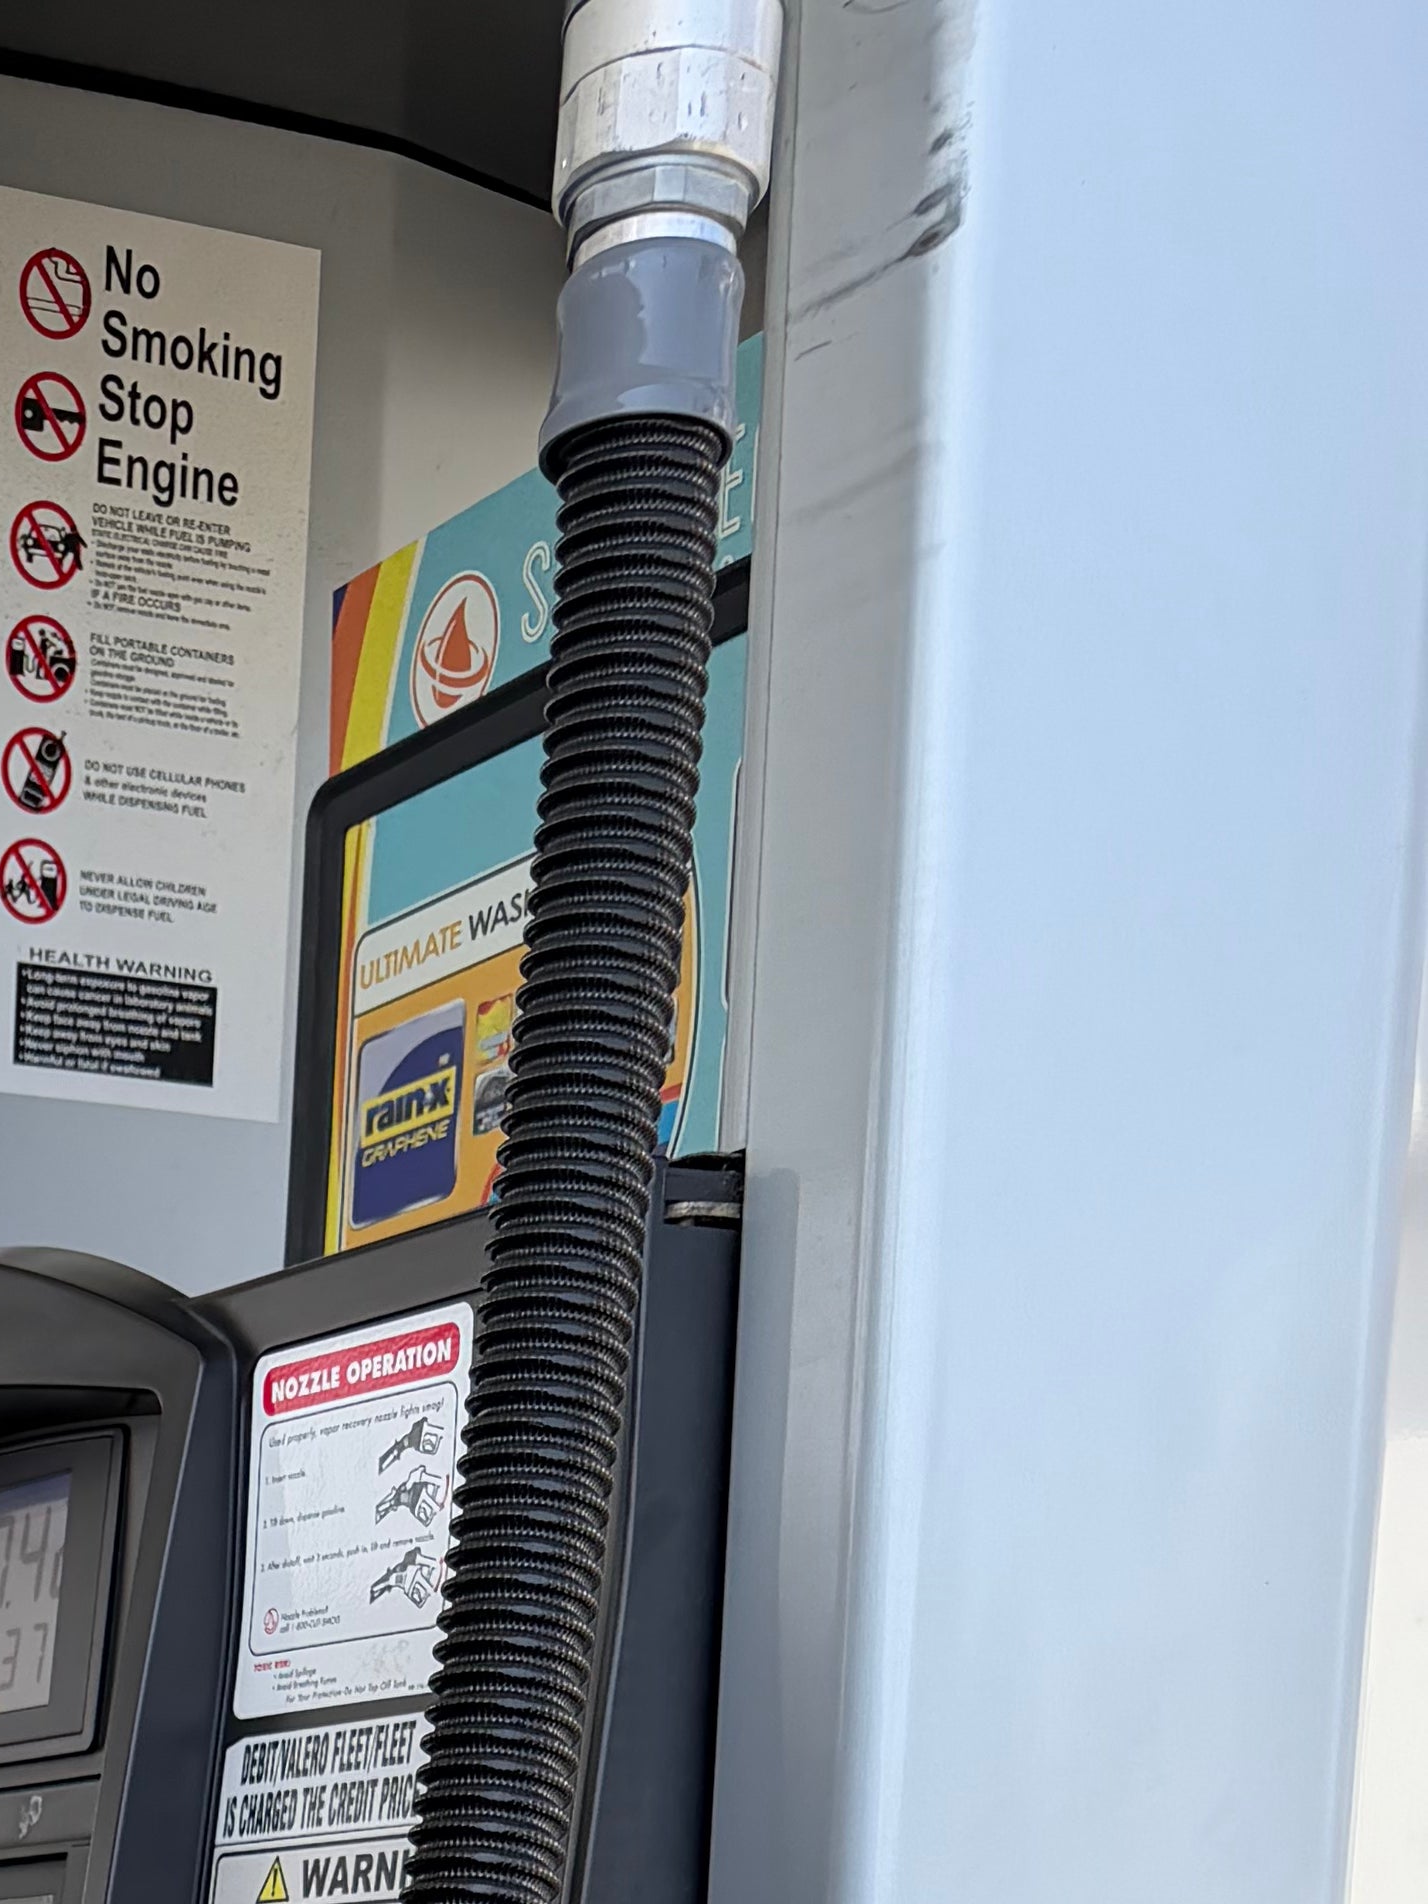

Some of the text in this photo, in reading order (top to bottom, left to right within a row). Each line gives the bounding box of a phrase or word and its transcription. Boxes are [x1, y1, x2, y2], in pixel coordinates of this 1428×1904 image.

[104, 245, 161, 300] No
[100, 309, 283, 400] Smoking
[98, 374, 194, 444] Stop
[96, 437, 239, 507] Engine
[92, 516, 134, 533] VEHICLE
[137, 522, 166, 538] WHILE
[169, 528, 193, 543] FUEL
[196, 534, 205, 545] IS
[208, 536, 251, 552] PUMPING
[93, 503, 106, 514] DO
[110, 505, 129, 518] NOT
[133, 508, 164, 524] LEAVE
[138, 596, 181, 612] OCCURS
[90, 633, 235, 666] FILL PORTABLE CONTAINERS
[130, 651, 175, 668] GROUND
[85, 760, 100, 772] DO
[126, 766, 146, 778] USE
[149, 769, 203, 786] CELLULAR
[205, 777, 246, 793] PHONES
[122, 782, 168, 798] electronic
[171, 789, 207, 802] devices
[181, 804, 207, 818] FUEL
[30, 947, 212, 984] HEALTH WARNING
[359, 919, 463, 990] ULTIMATE
[361, 1119, 451, 1168] GRAPHENE
[271, 1338, 452, 1404] NOZZLE OPERATION
[241, 1720, 416, 1786] DEBIT/VALERO FLEET/FLEET
[223, 1795, 237, 1839] IS
[239, 1788, 298, 1836] CHARGED
[300, 1784, 327, 1830] THE
[328, 1778, 378, 1826] CREDIT
